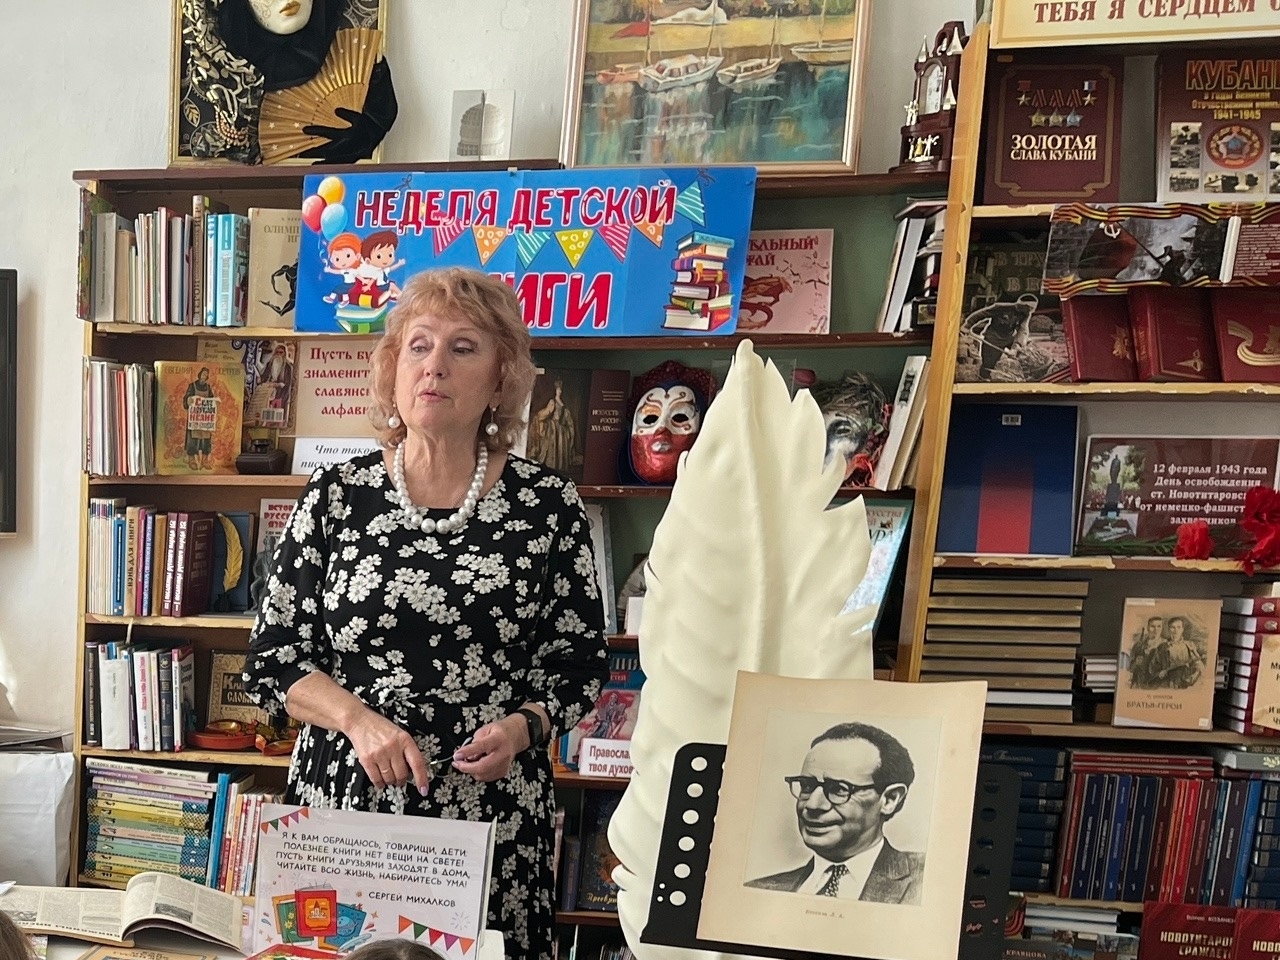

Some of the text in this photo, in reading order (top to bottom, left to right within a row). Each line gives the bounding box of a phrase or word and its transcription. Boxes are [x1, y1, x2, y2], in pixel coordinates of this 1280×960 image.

[1034, 0, 1097, 23] ТЕБЯ
[1108, 0, 1125, 19] Я
[1214, 109, 1260, 119] 1941-1945
[1011, 134, 1097, 150] ЗОЛОТАЯ
[1010, 149, 1097, 161] СЛАВА КУБАНИ
[355, 180, 678, 234] НЕДЕЛЯ ДЕТСКОЙ
[487, 272, 613, 329] ИГИ
[310, 348, 352, 363] Пусть
[315, 444, 339, 454] Что
[1153, 463, 1268, 475] 12 февраля 1943 года
[1154, 476, 1182, 487] День
[1150, 490, 1166, 499] ст.
[1140, 503, 1153, 511] от
[589, 745, 631, 760] Правосла
[588, 762, 608, 773] твоя
[292, 832, 298, 840] К
[301, 833, 319, 842] ВАМ
[323, 835, 381, 849] ОБРАЩАЮСЬ,
[385, 842, 437, 855] ТОВАРИЩИ,
[283, 842, 465, 867] ПОЛЕЗНЕЕ КНИГИ НЕТ ВЕЩИ НА СВЕТЕ!
[276, 851, 470, 880] ПУСТЬ КНИГИ ДРУЗЬЯМИ ЗАХОДЯТ В ДОМА,
[276, 861, 468, 888] ЧИТАЙТЕ ВСЮ ЖИЗНЬ, НАБИРАЙТЕСЬ УМА!
[368, 890, 456, 908] СЕРГЕЙ МИХАЛКОВ
